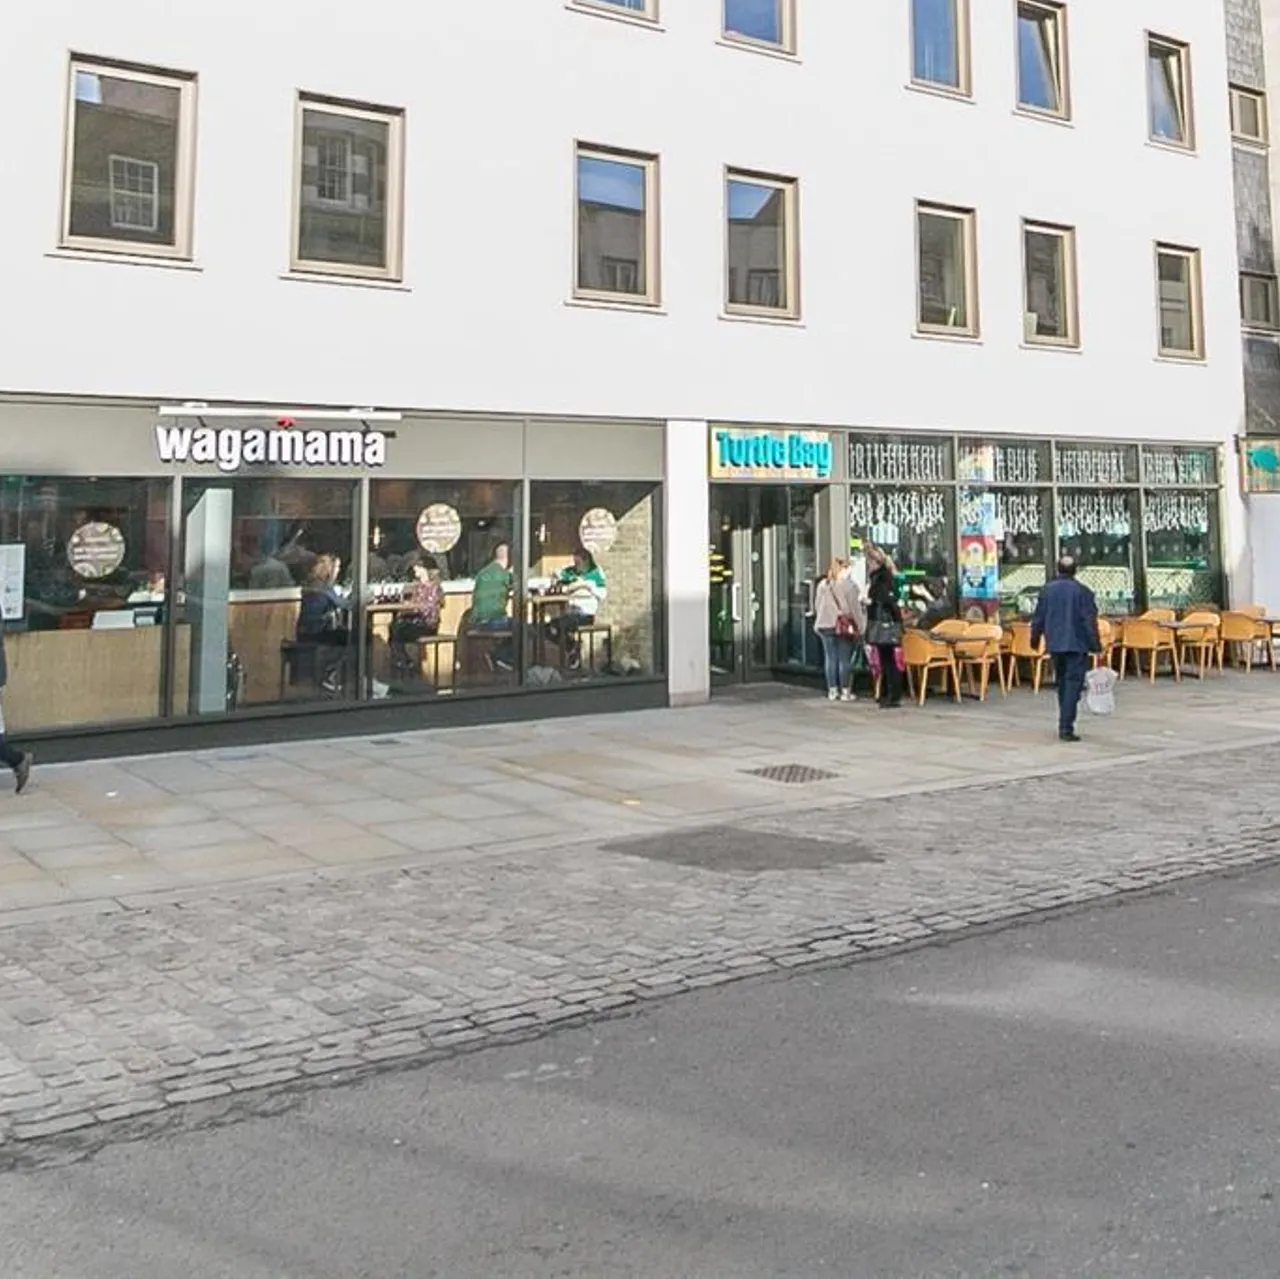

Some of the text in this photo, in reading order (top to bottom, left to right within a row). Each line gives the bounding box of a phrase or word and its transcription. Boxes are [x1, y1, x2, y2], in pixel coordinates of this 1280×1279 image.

[156, 424, 387, 472] wagamama
[715, 431, 786, 468] Turtle
[787, 433, 831, 478] Bay
